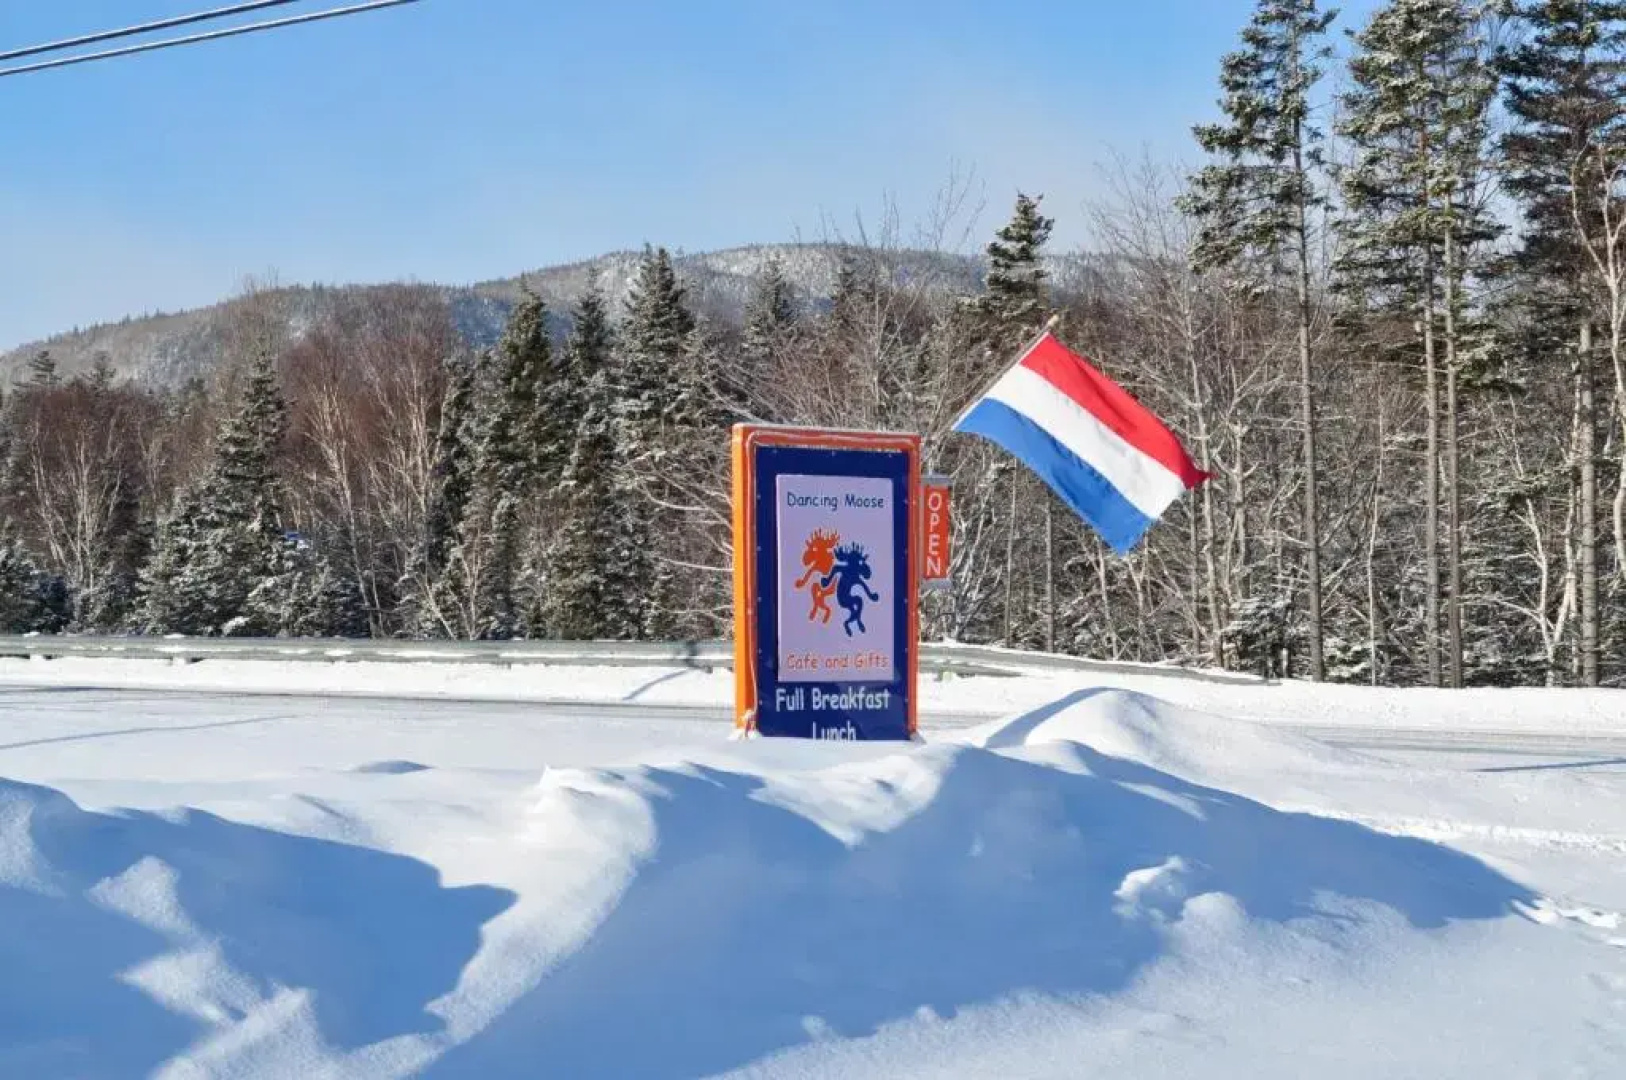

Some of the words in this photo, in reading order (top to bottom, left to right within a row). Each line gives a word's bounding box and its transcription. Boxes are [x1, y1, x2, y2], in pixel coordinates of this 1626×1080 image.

[787, 491, 838, 511] Dancing
[845, 493, 884, 508] Moose
[927, 491, 942, 576] OPEN
[825, 654, 849, 668] and
[854, 652, 889, 668] Gifts
[775, 687, 804, 712] Full
[812, 686, 890, 710] Breakfast
